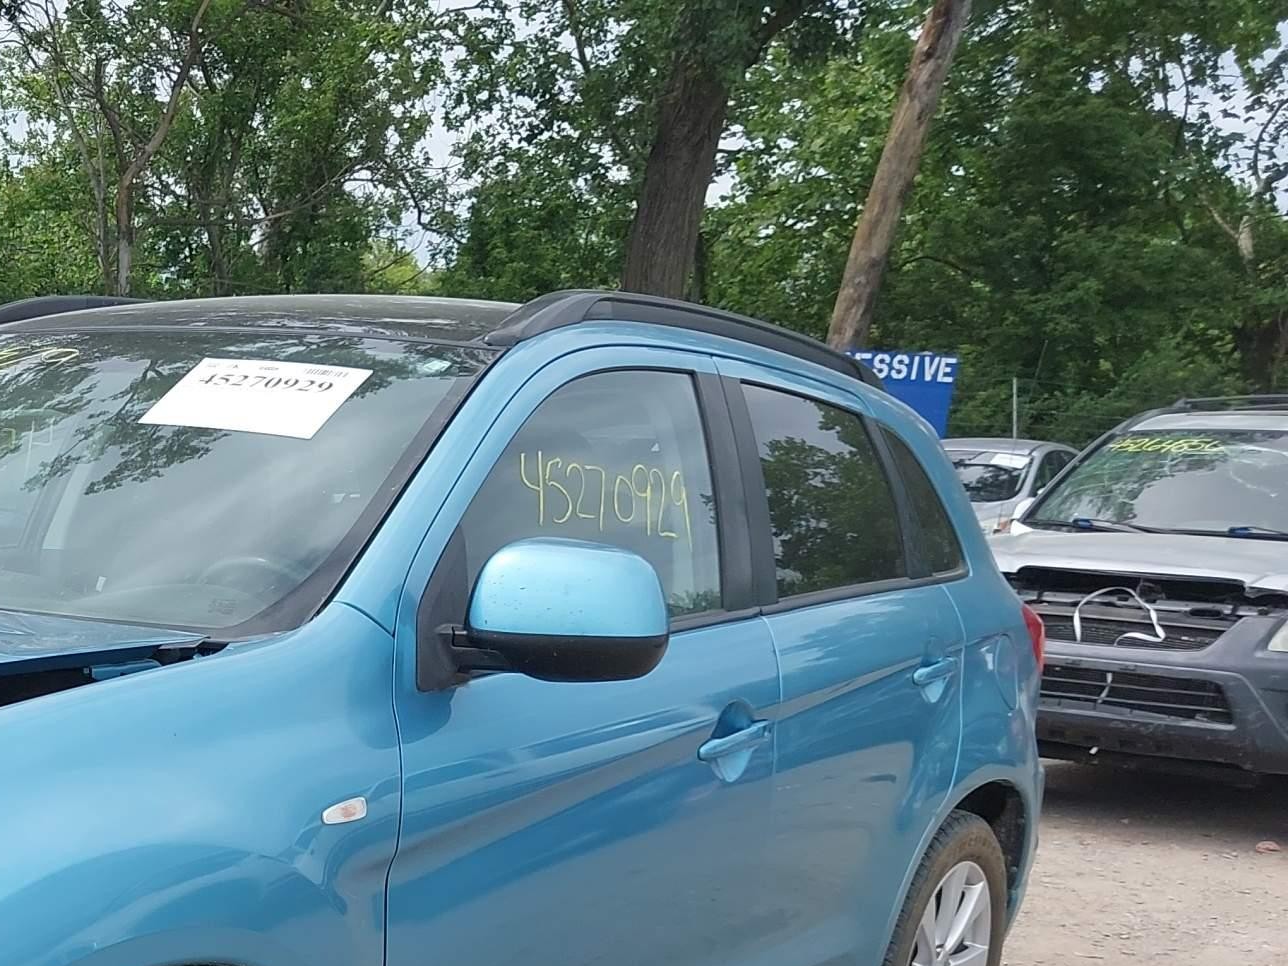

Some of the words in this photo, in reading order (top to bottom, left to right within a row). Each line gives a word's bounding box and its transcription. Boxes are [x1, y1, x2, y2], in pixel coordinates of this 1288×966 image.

[199, 372, 335, 393] 45270929
[845, 352, 958, 383] SSIVE
[520, 450, 694, 551] 45270929
